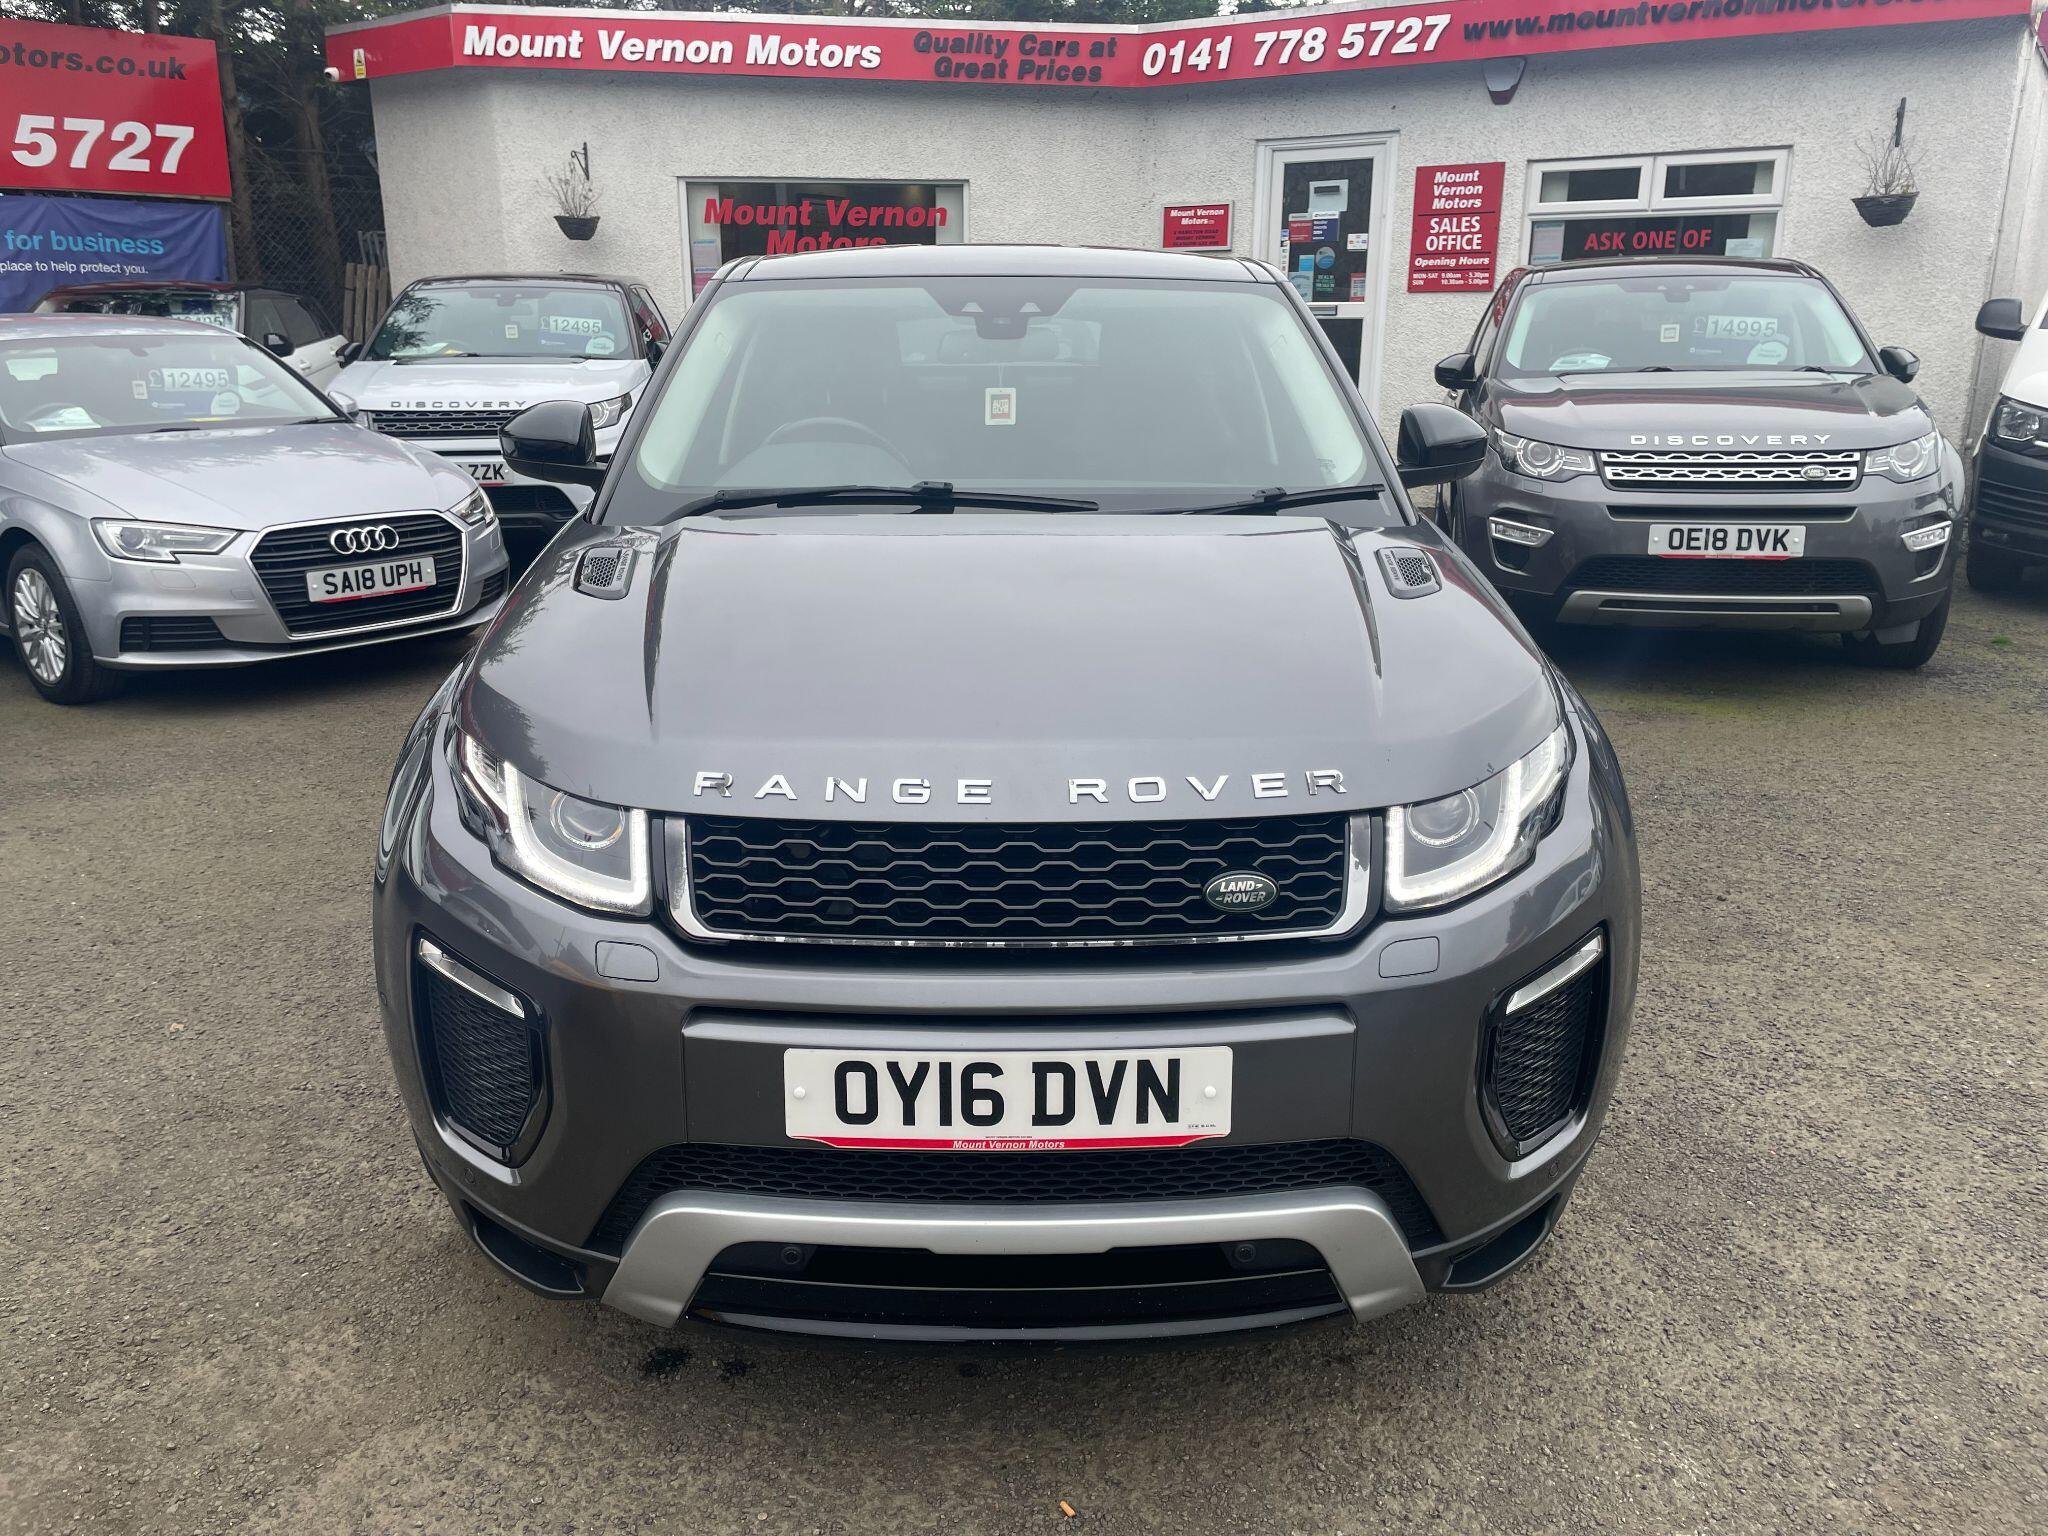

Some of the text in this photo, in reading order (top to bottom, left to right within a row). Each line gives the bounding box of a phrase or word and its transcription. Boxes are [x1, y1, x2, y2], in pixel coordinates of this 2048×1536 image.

[463, 25, 881, 69] Mount Vernon Motors
[914, 31, 1118, 59] Quality Cars at
[1142, 13, 1451, 76] 0141 778 5727
[934, 56, 1102, 82] Great Prices
[11, 113, 195, 174] 5727
[1434, 170, 1480, 183] Mount
[1433, 184, 1483, 196] Vernon
[704, 198, 948, 227] Mount Vernon
[1170, 208, 1224, 217] Mount Vernon
[1432, 198, 1482, 210] Motors
[1429, 216, 1480, 233] SALES
[4, 229, 165, 255] for business
[1425, 234, 1482, 251] OFFICE
[1584, 229, 1712, 251] ASK ONE OF
[35, 261, 48, 272] to
[51, 261, 77, 274] help
[80, 262, 121, 275] protect
[124, 264, 149, 276] you.
[1414, 256, 1490, 267] Opening Hours
[1630, 434, 1831, 446] DISCOVERY
[1668, 527, 1790, 552] OE18 DVK
[323, 561, 423, 595] SA18 UPH
[694, 769, 1348, 805] RANGE ROVER
[1220, 881, 1255, 893] LAND
[1223, 891, 1266, 903] ROVER
[834, 1058, 1181, 1127] OY16 DVN
[953, 1140, 1065, 1149] Mount Vernon Motors
